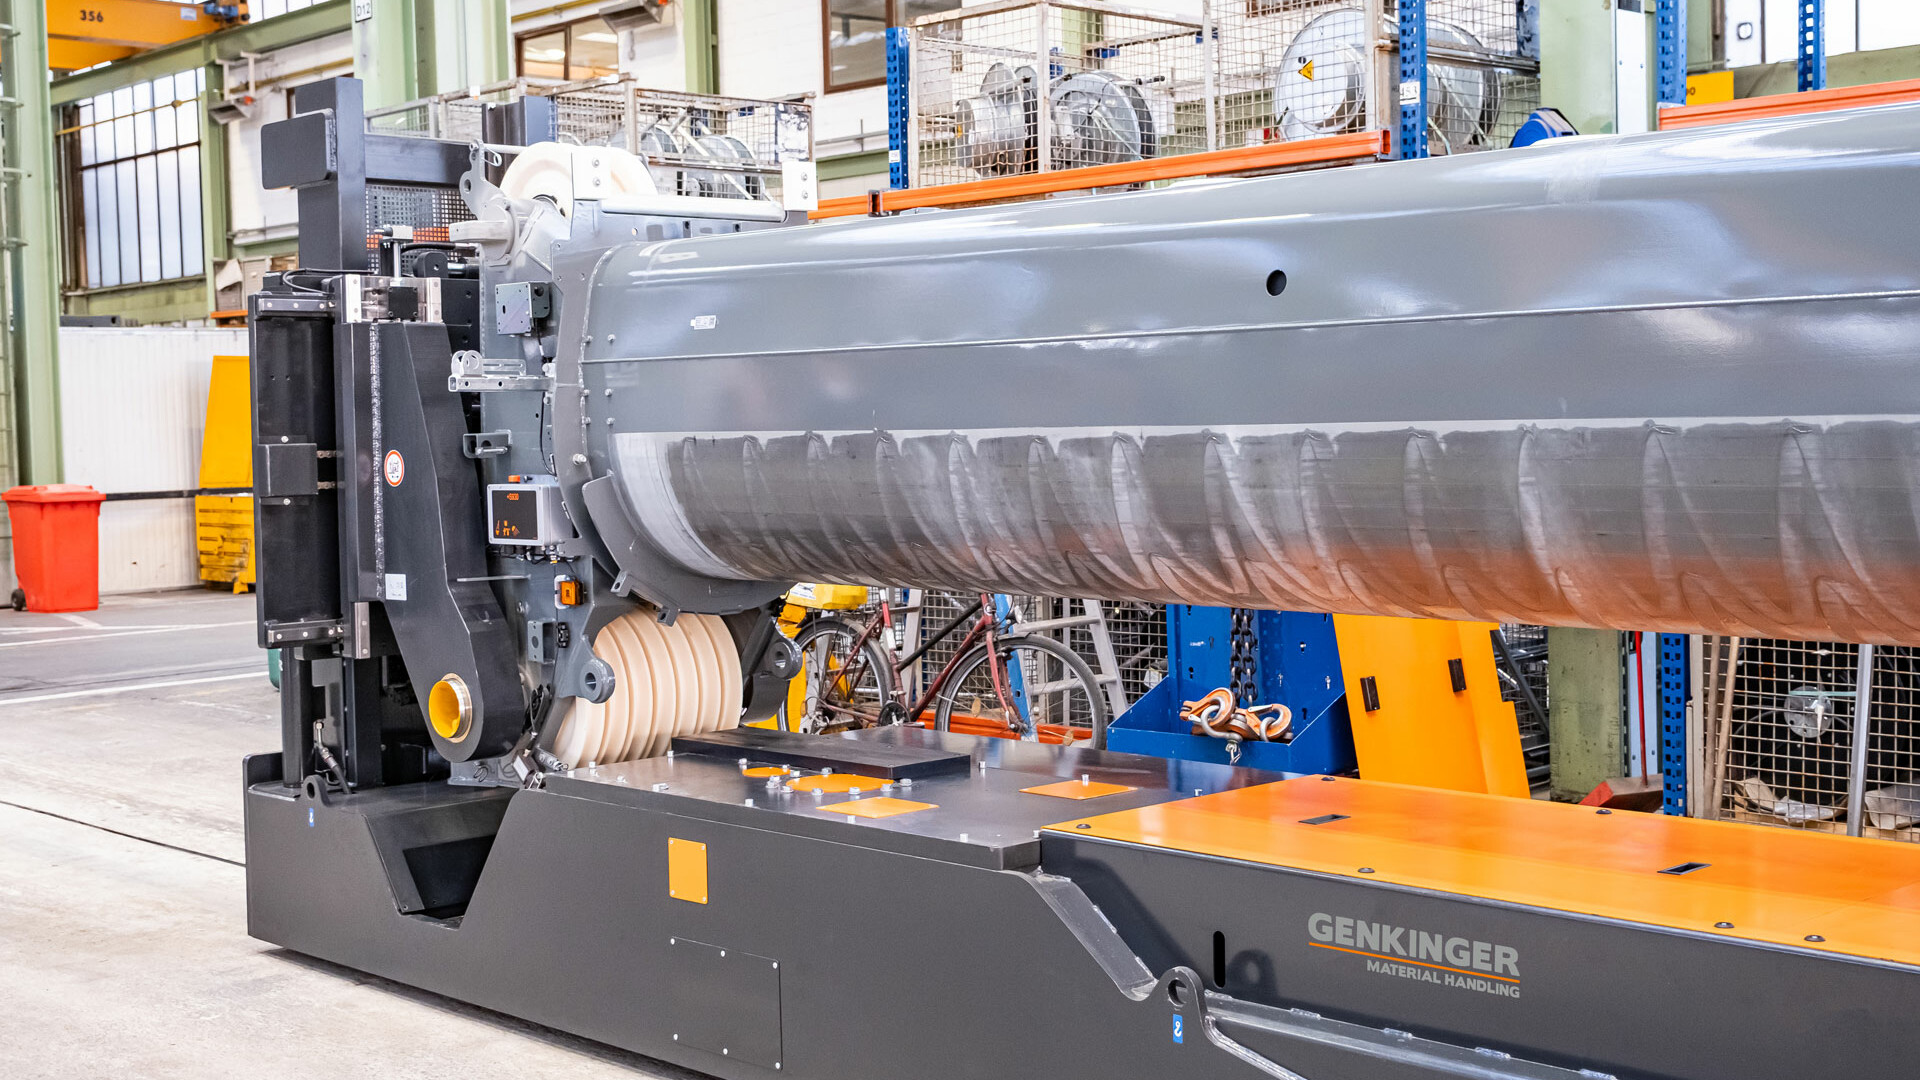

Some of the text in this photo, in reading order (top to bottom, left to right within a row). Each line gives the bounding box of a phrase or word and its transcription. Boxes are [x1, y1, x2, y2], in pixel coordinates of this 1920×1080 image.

[80, 9, 104, 23] 356
[356, 2, 371, 17] D12
[1307, 912, 1521, 977] GENKINGER
[1366, 959, 1521, 999] MATERIAL HANDLING
